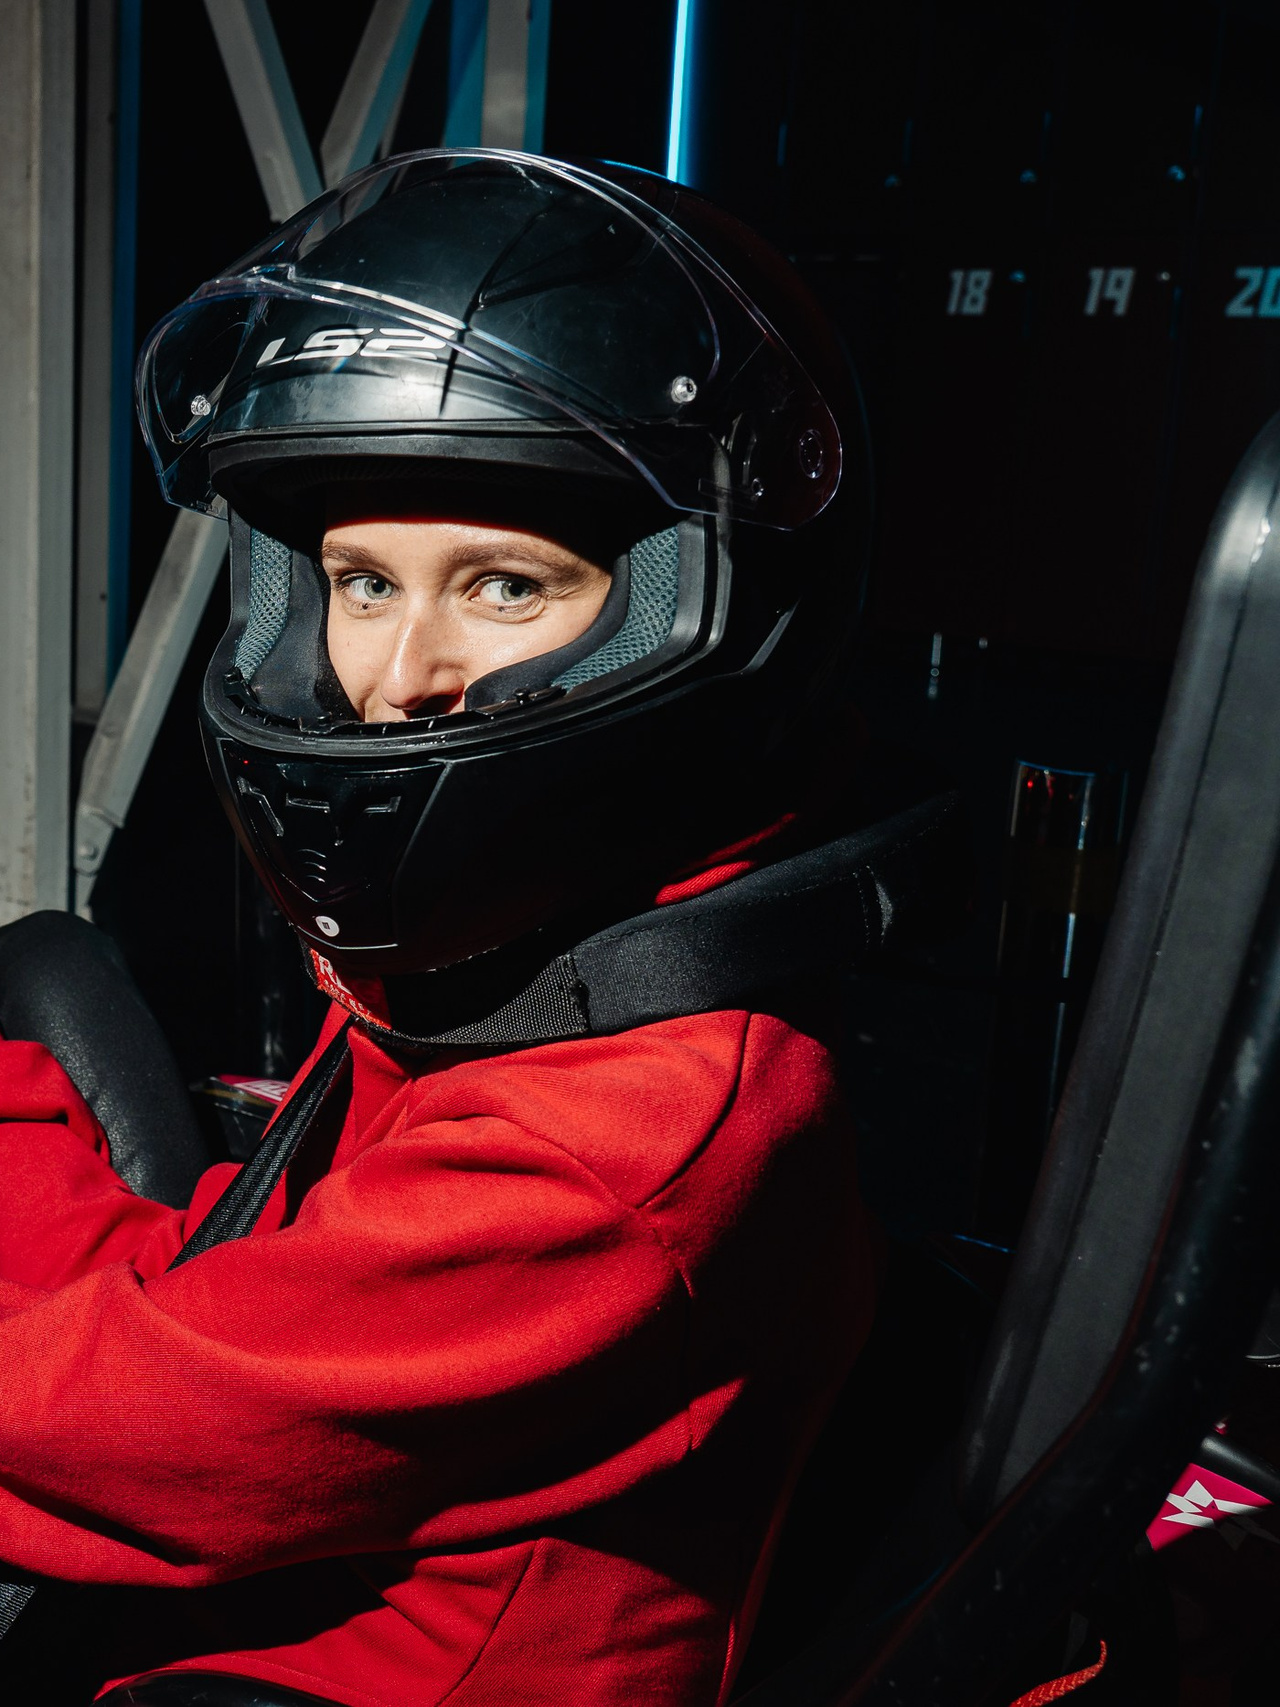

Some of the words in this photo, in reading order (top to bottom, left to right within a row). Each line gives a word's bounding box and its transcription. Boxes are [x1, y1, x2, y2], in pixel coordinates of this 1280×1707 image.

[946, 268, 993, 317] 18
[1083, 266, 1136, 317] 19
[255, 327, 448, 369] LS2
